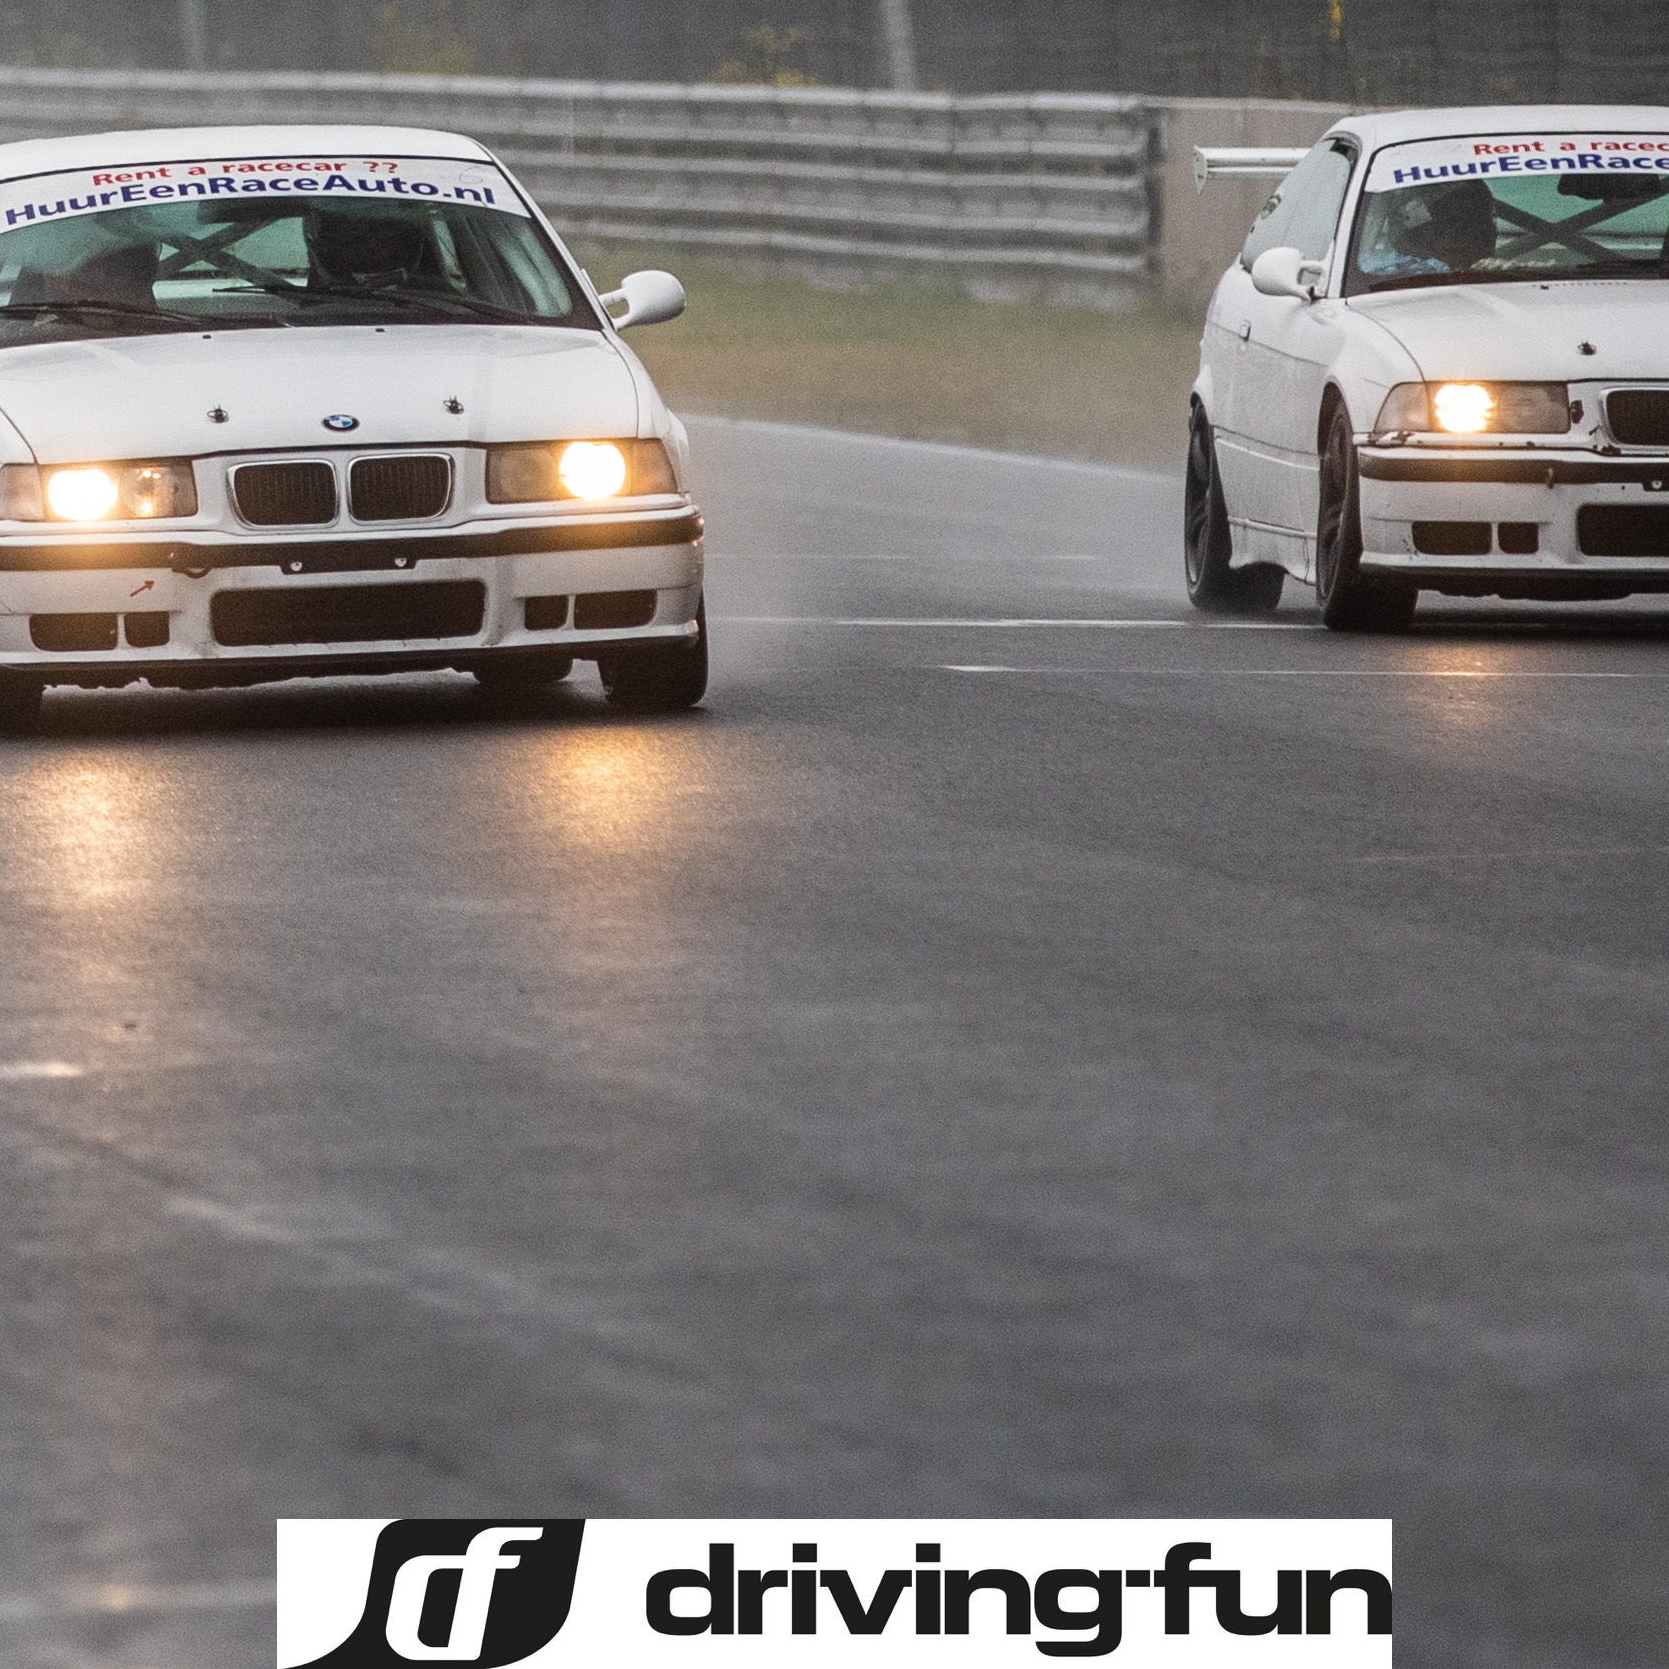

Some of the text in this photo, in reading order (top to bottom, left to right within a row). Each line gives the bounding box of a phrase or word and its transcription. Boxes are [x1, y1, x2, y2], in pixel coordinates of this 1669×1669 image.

[1473, 141, 1545, 155] Rent
[1559, 141, 1576, 151] a
[92, 161, 399, 186] Rent a racecar ??
[5, 174, 496, 225] HuurEenRaceAuto.nl
